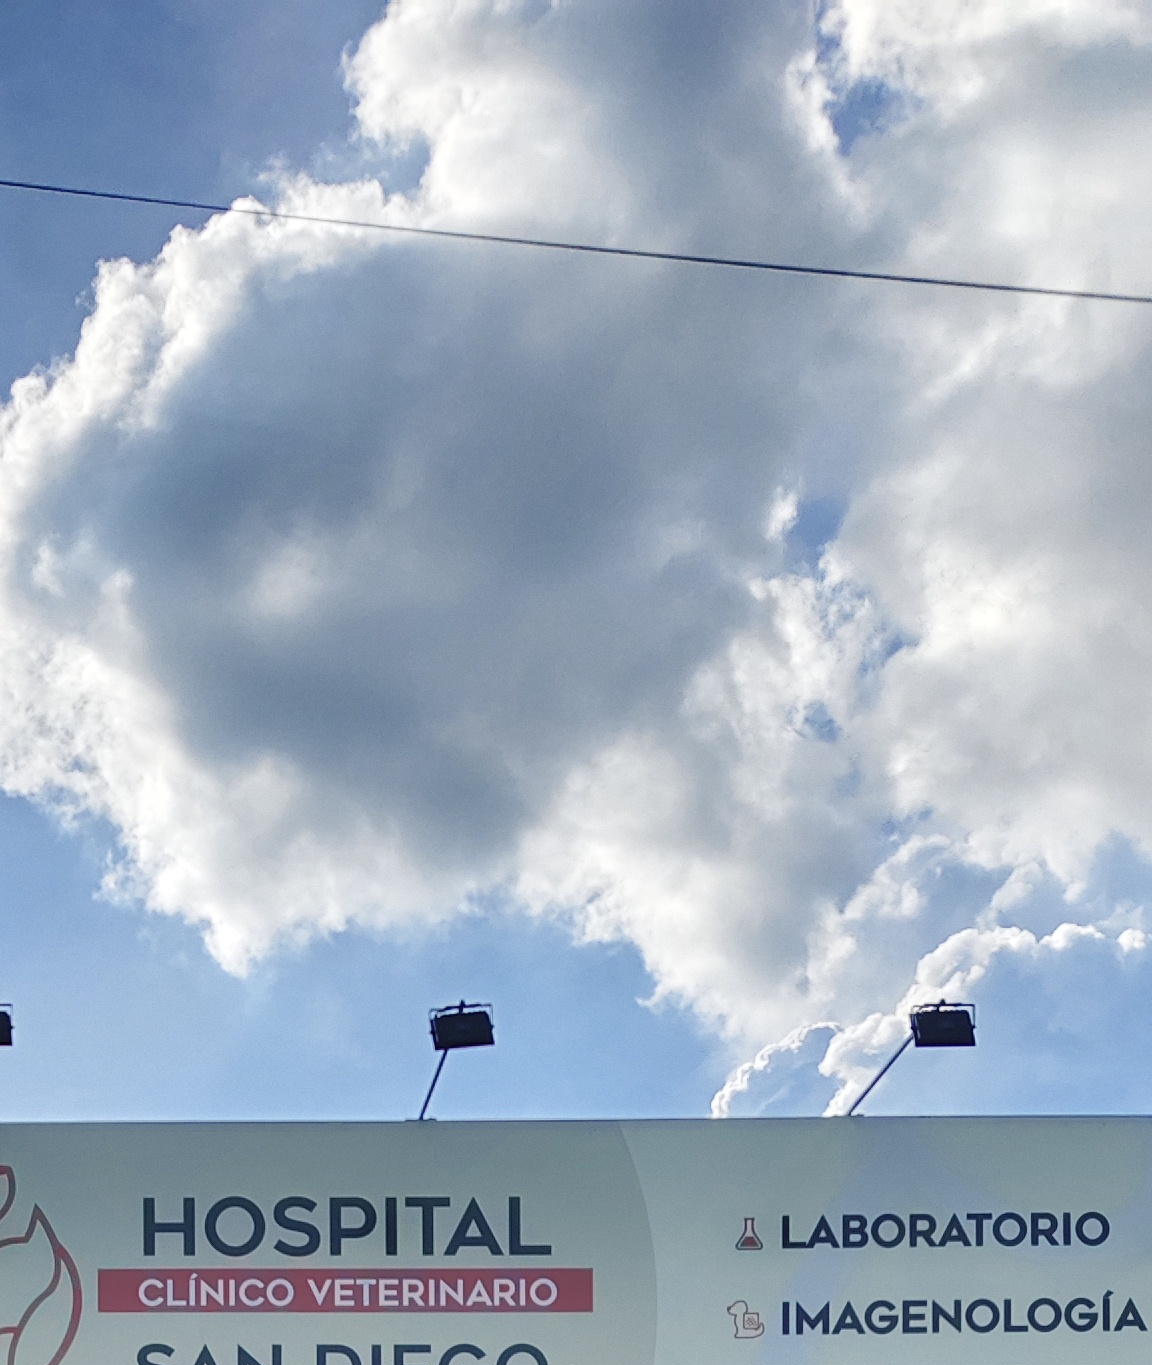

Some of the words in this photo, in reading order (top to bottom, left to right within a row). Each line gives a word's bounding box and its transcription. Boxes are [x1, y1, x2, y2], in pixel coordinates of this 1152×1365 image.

[143, 1196, 552, 1257] HOSPITAL
[781, 1211, 1110, 1249] LABORATORIO
[138, 1272, 295, 1307] CLÍNICO
[307, 1278, 558, 1307] VETERINARIO
[781, 1290, 1148, 1335] IMAGENOLOGÍA
